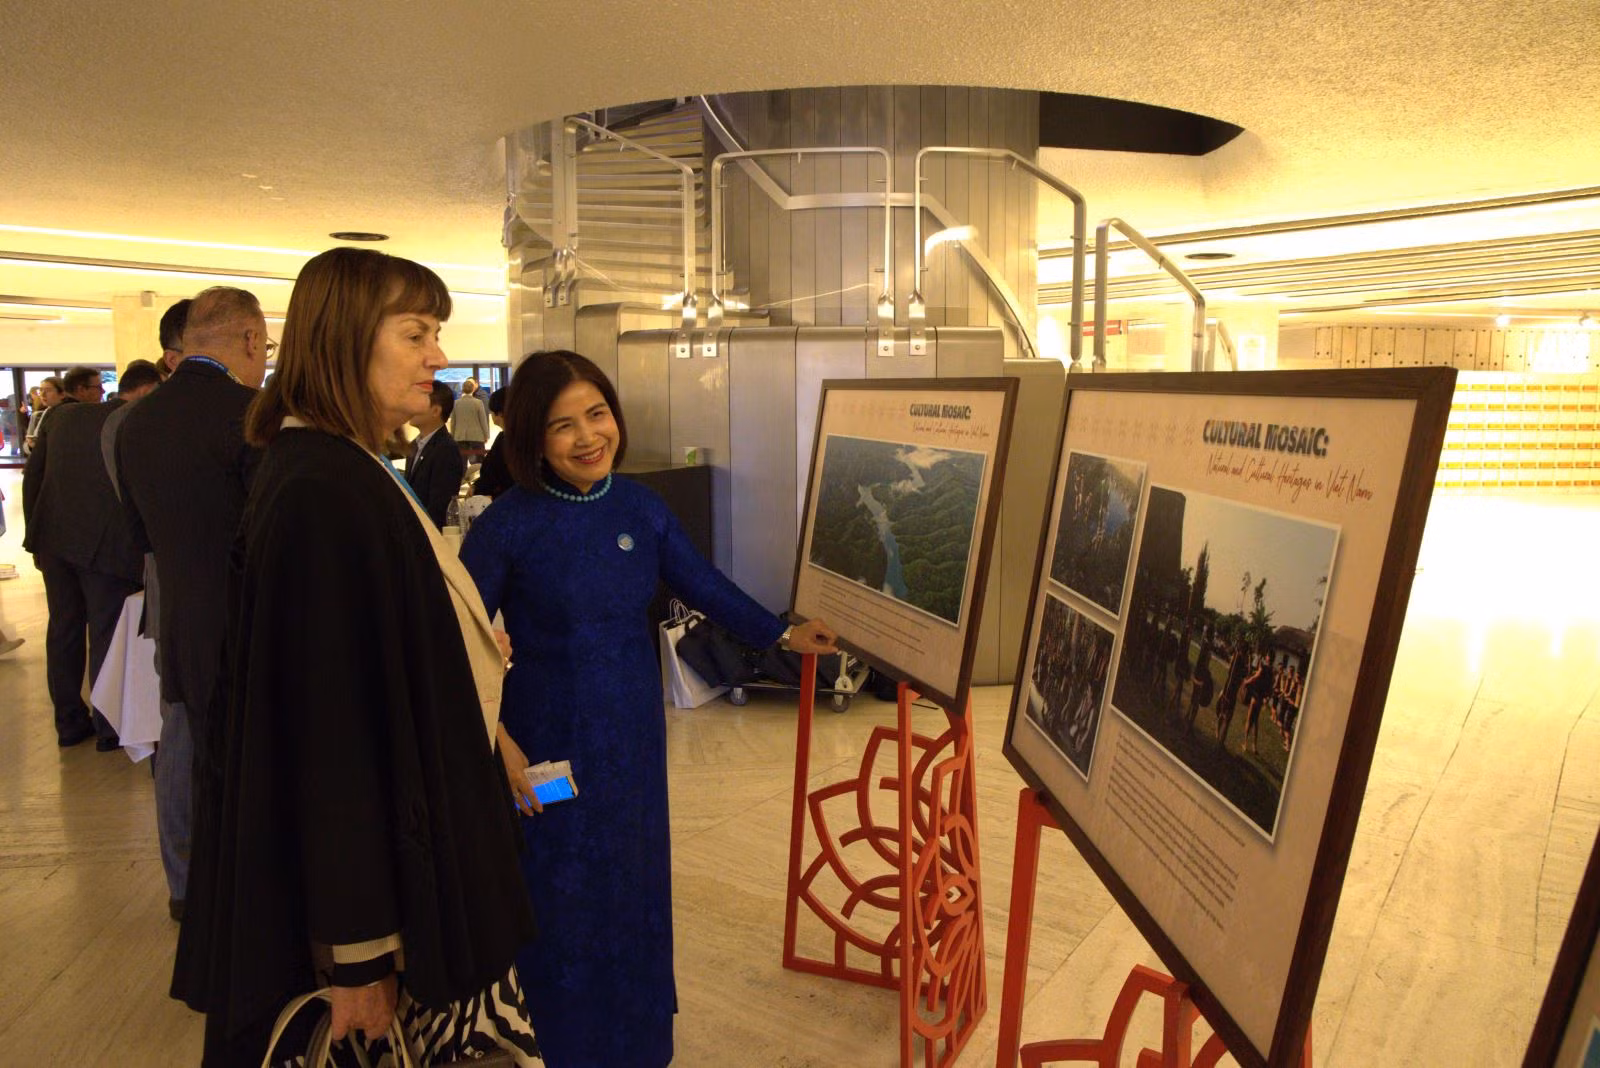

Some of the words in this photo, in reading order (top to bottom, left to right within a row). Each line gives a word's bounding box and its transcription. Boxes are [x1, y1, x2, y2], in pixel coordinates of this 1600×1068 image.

[910, 403, 941, 417] CULTURAL
[1203, 419, 1262, 449] CULTURAL
[1264, 423, 1329, 457] MOSAIC:
[1231, 455, 1248, 476] and
[1314, 479, 1323, 491] in
